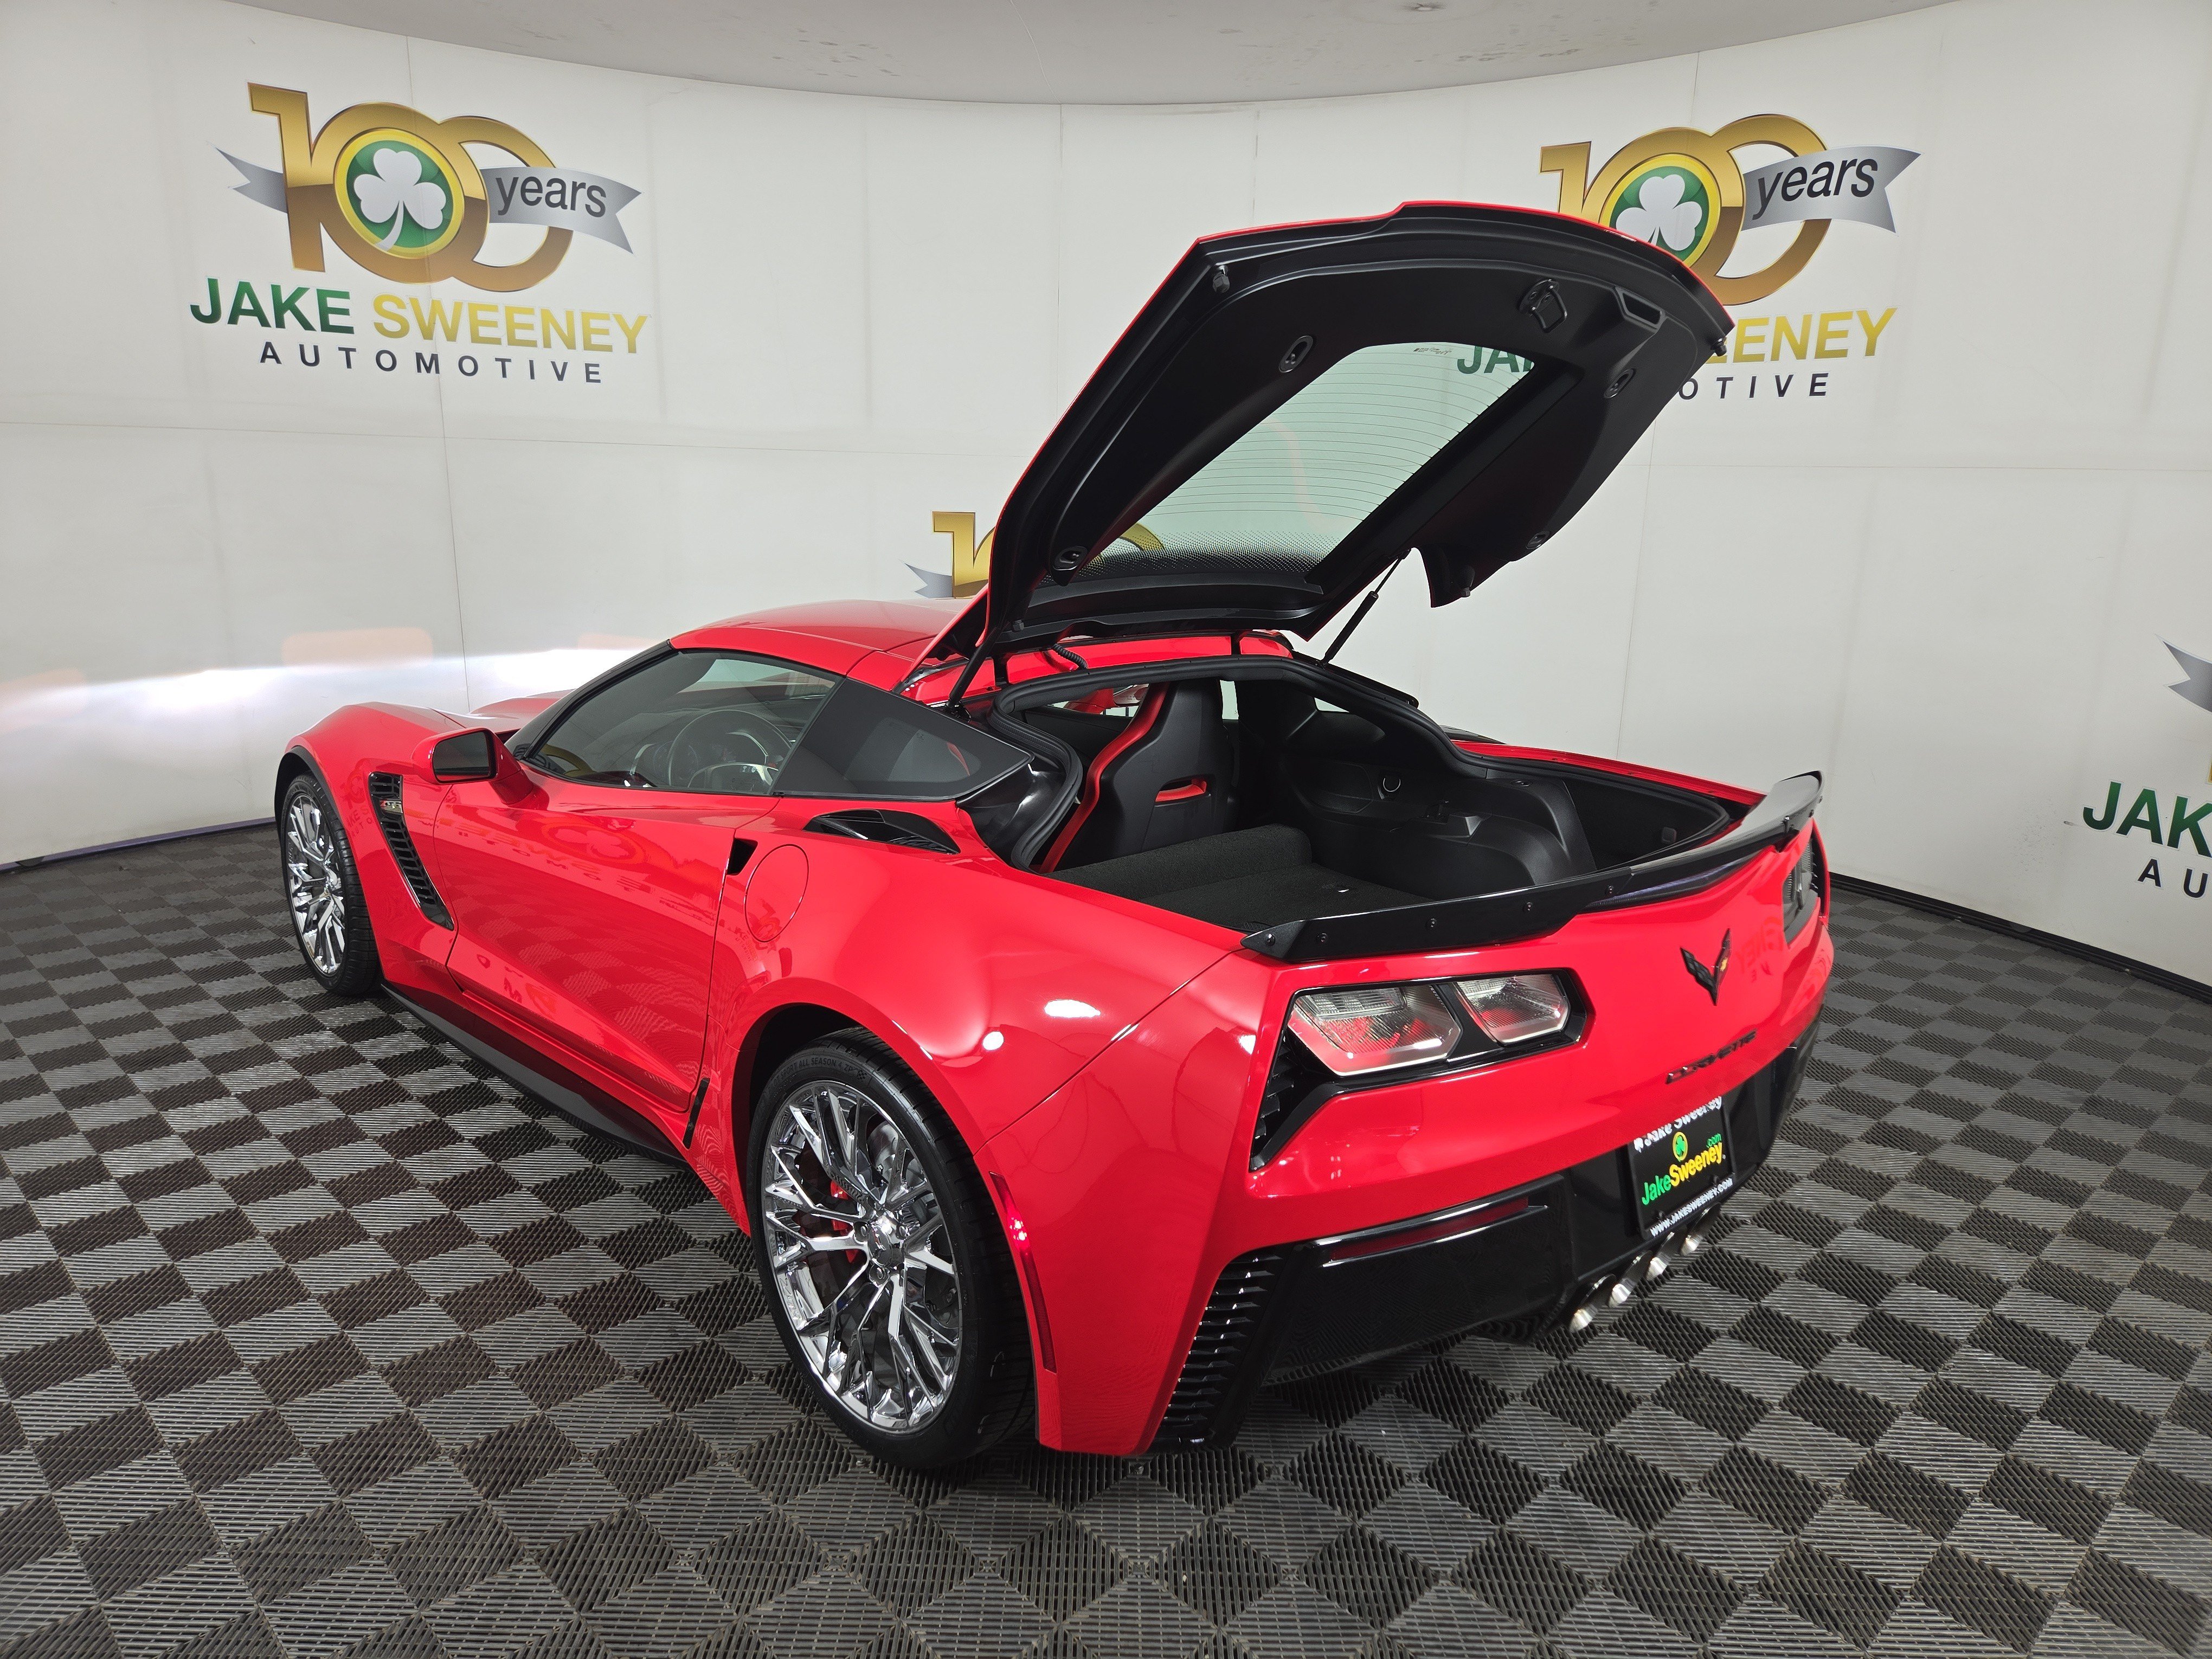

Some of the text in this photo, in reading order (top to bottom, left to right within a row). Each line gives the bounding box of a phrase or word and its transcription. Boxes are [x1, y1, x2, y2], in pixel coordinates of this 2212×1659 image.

[248, 82, 574, 292] 100
[496, 176, 608, 218] years
[1753, 157, 1878, 220] years
[190, 278, 650, 354] JAKE SWEENEY
[260, 342, 602, 383] AUTOMOTIVE
[1457, 346, 1532, 375] JA
[1679, 372, 1829, 400] OTIVE
[811, 1057, 837, 1067] SEASON
[1650, 1178, 1733, 1237] WWW.JAKESWEENEY.COM
